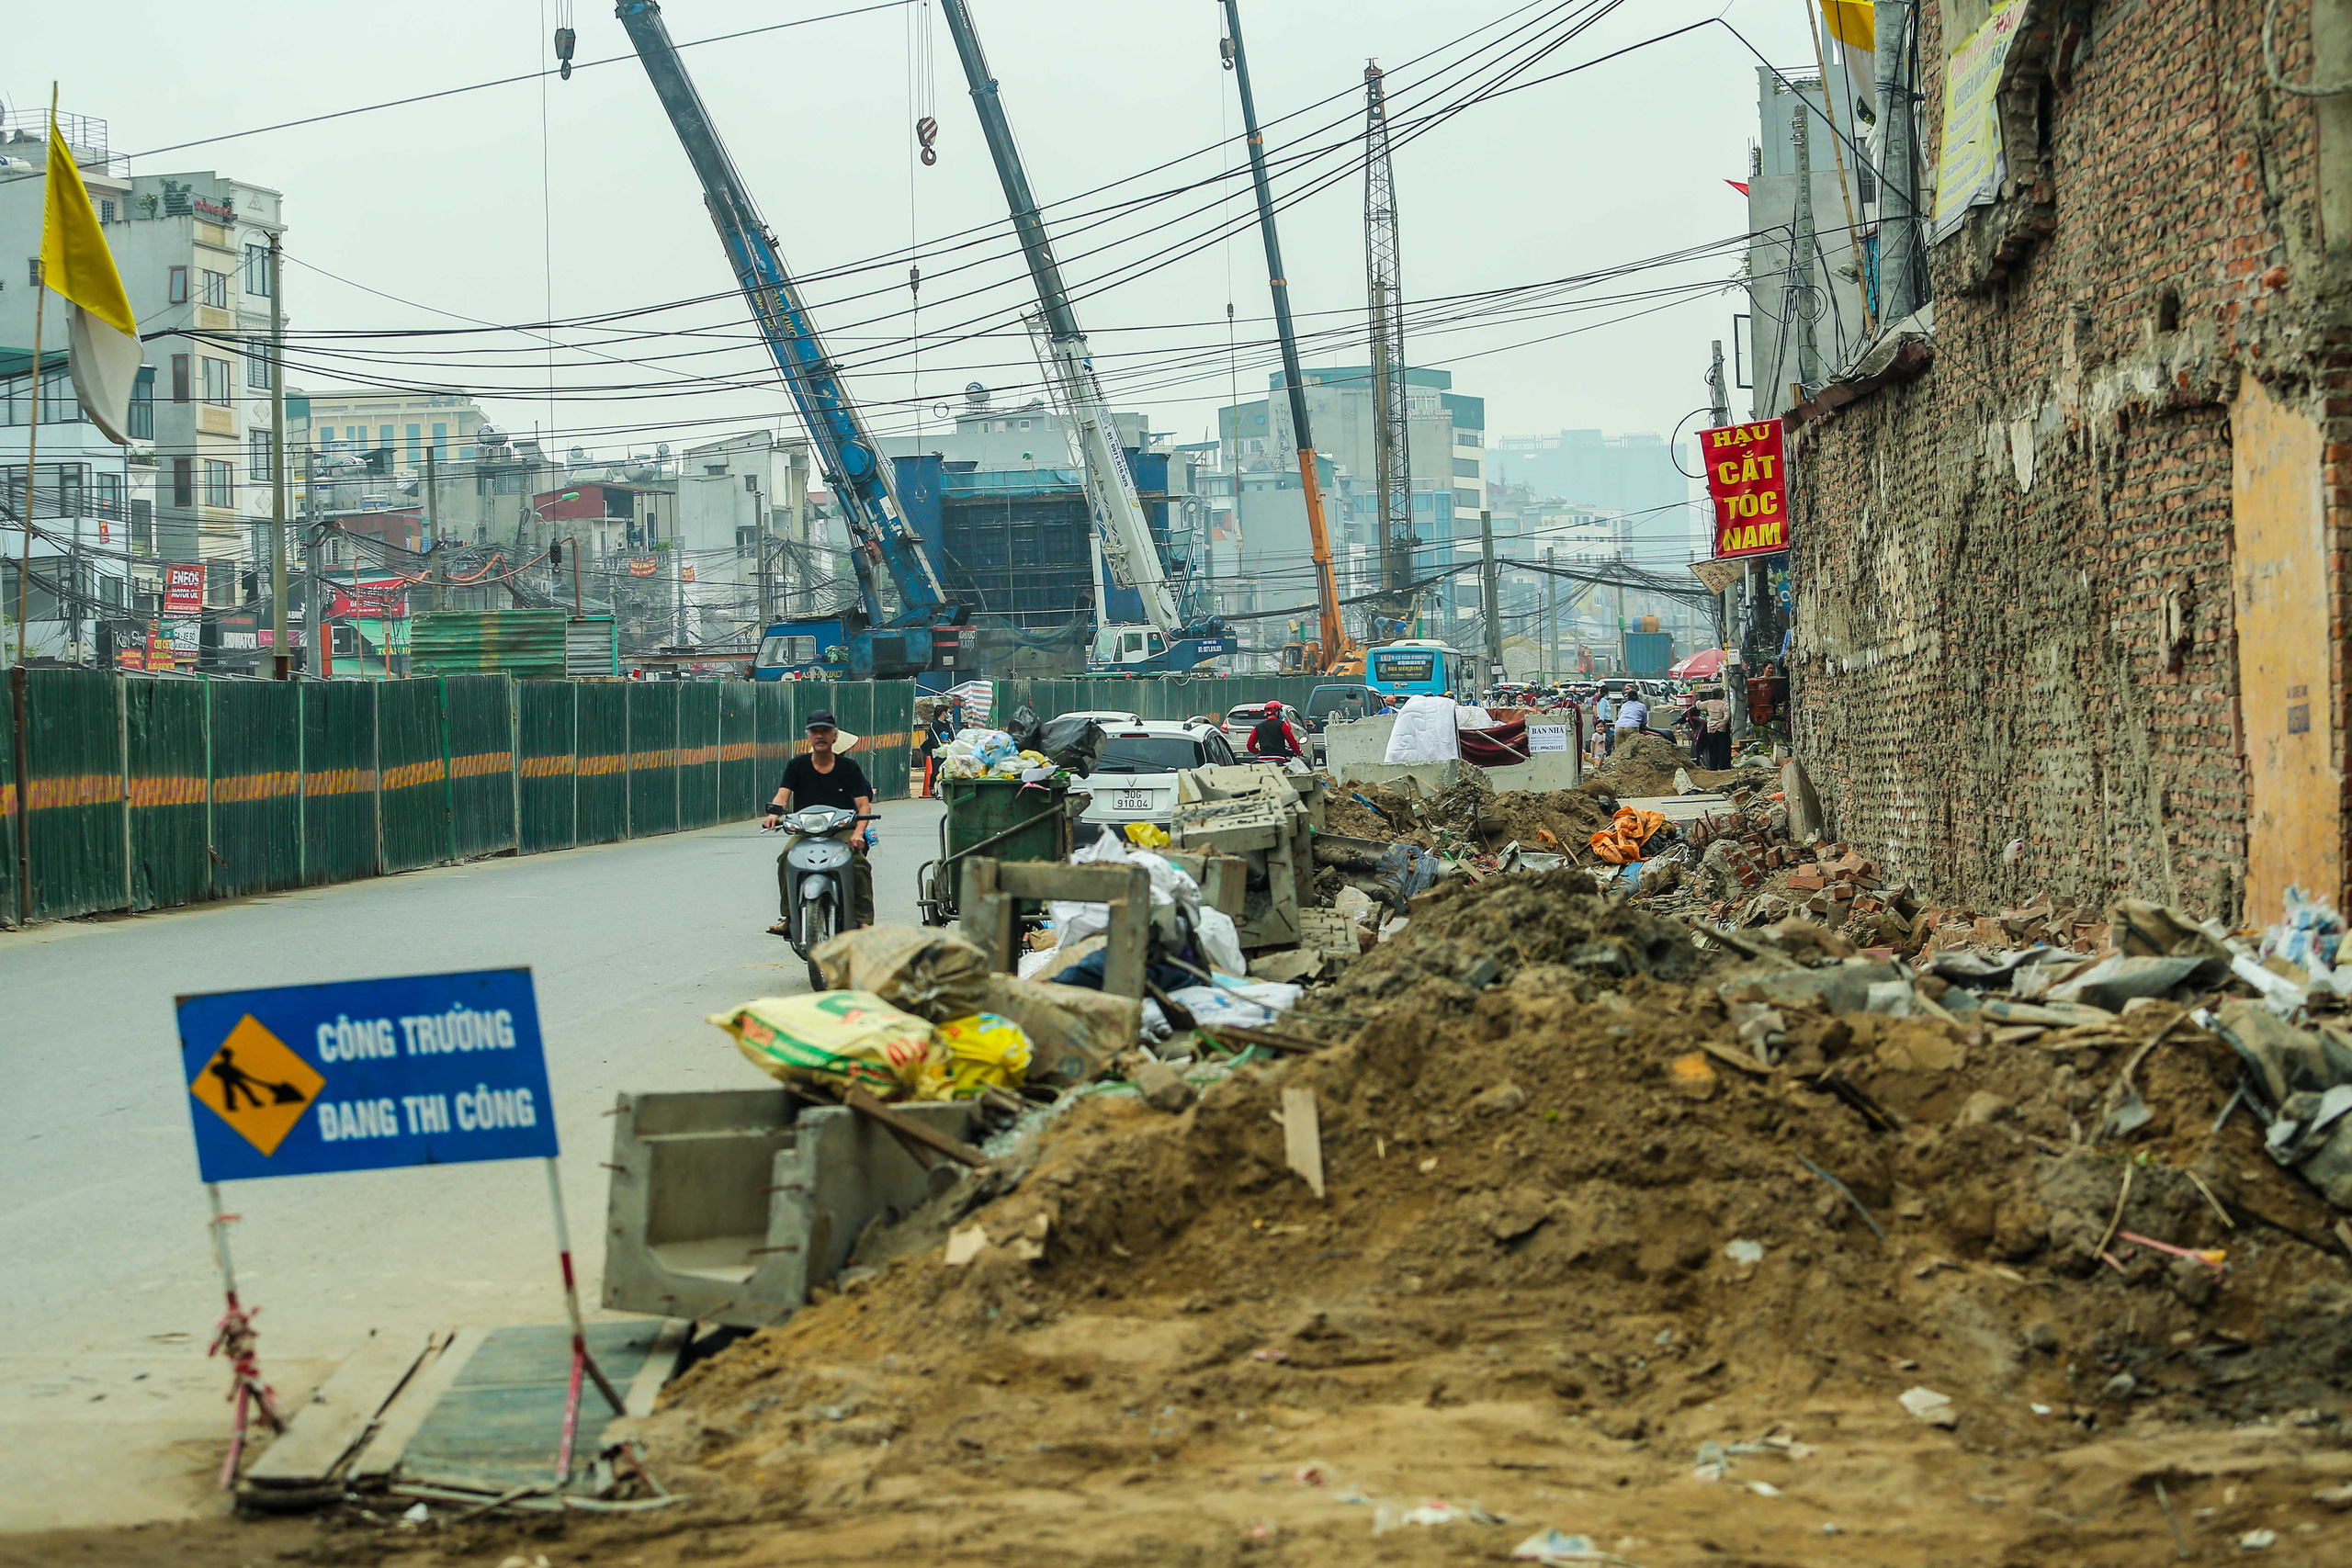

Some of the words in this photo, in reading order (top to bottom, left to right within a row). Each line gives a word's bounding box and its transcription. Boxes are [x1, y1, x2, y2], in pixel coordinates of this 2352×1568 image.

[1712, 424, 1770, 448] HẬU
[1718, 449, 1776, 485] CẮT
[1724, 489, 1778, 520] TÓC
[1723, 522, 1782, 551] NAM
[172, 570, 199, 586] ENEOS
[1548, 725, 1565, 734] NHÀ
[1117, 799, 1148, 808] 910.04
[1125, 790, 1142, 799] 30G
[316, 1014, 397, 1063] CÔNG
[400, 1001, 516, 1055] TRƯỜNG
[318, 1100, 399, 1142] ĐANG
[402, 1094, 450, 1134] THI
[455, 1082, 537, 1131] CÔNG
